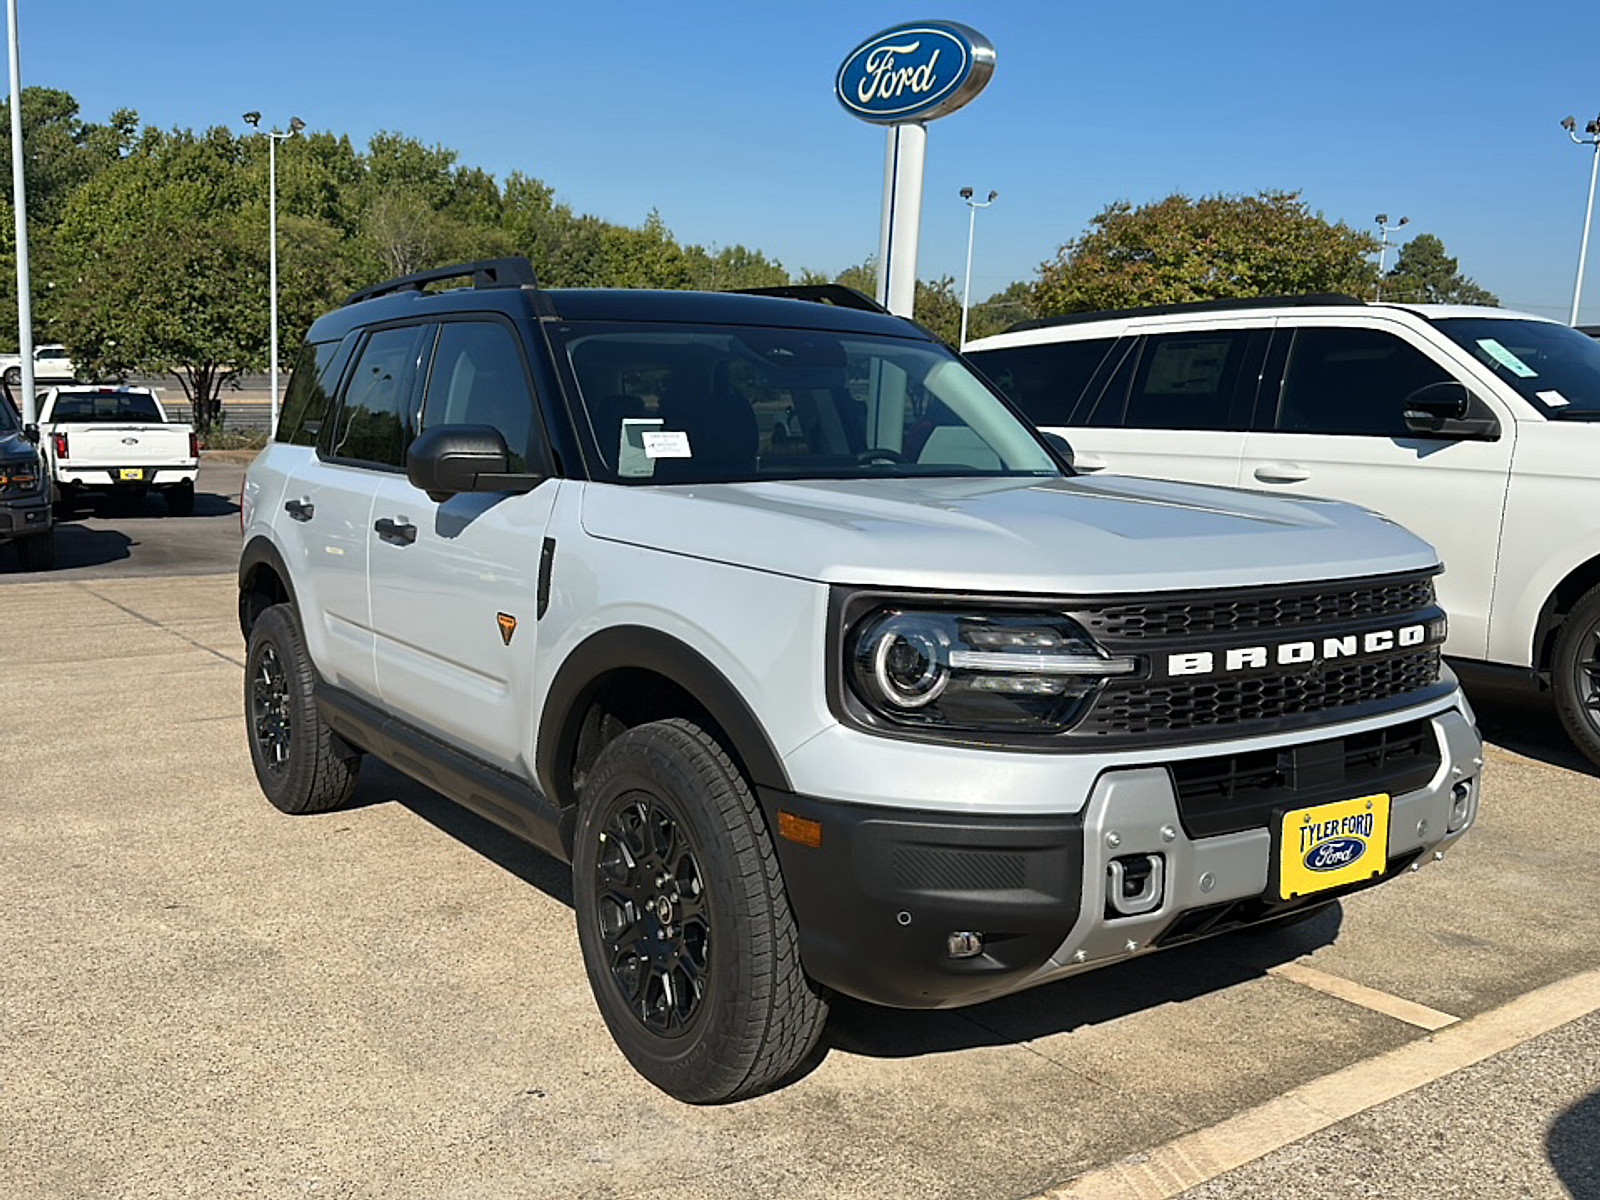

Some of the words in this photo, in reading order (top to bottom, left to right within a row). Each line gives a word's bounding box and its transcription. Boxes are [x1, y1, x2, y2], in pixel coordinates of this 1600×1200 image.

[857, 40, 941, 103] Ford
[1167, 624, 1425, 676] BRONCO
[1299, 820, 1340, 853] TYLER
[1341, 813, 1373, 837] FORD
[1315, 841, 1354, 866] Ford
